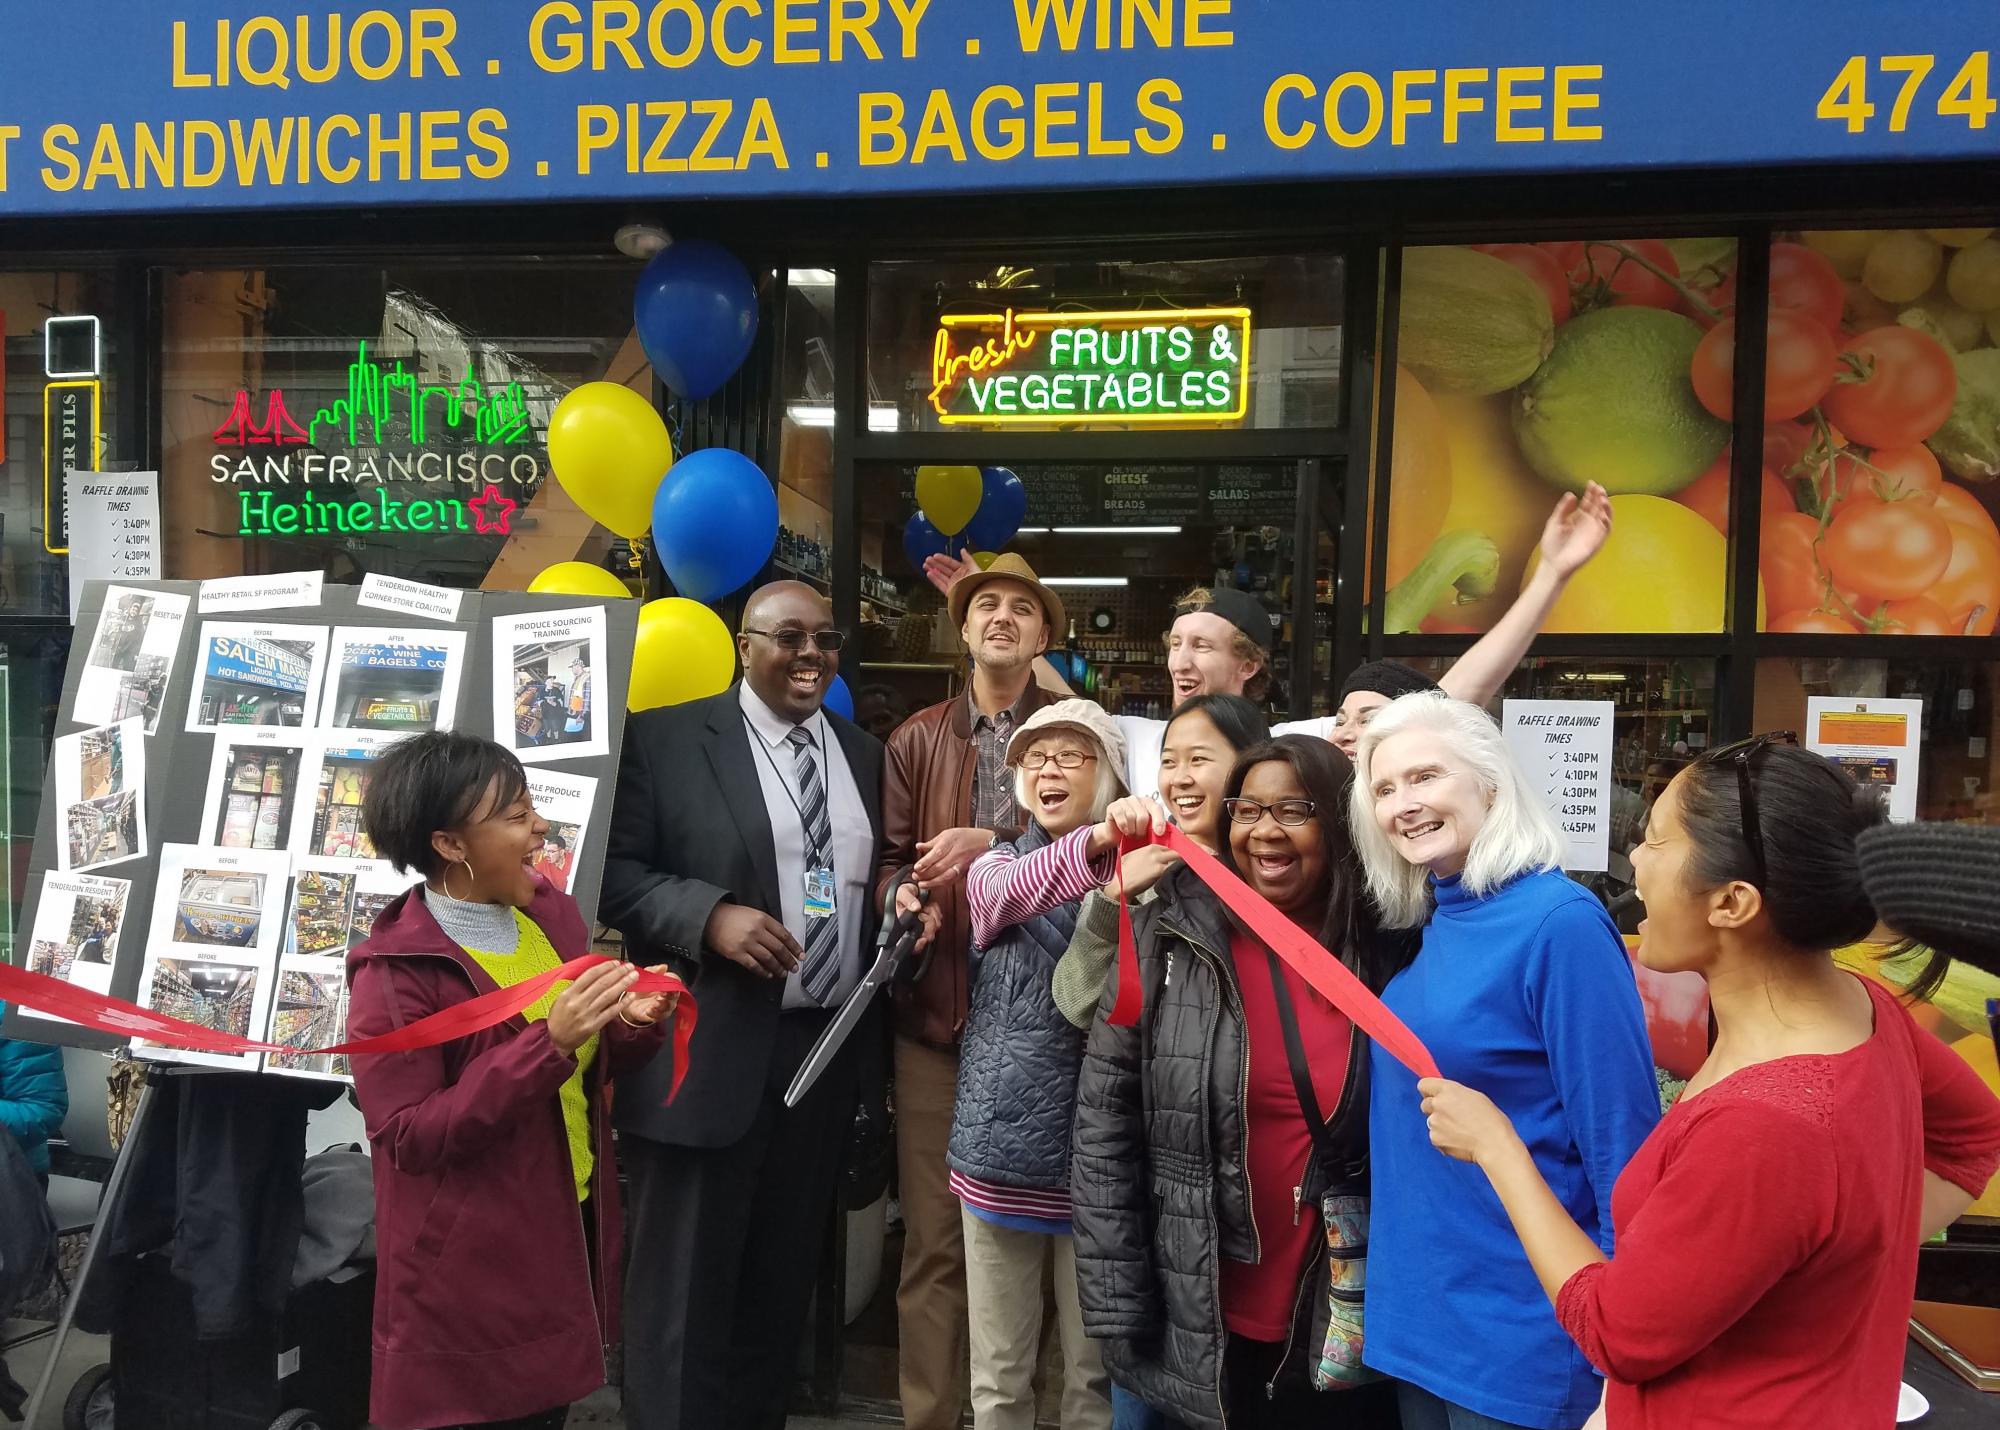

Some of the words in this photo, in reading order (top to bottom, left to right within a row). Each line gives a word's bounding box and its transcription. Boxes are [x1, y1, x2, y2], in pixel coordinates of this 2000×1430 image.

[172, 9, 460, 89] LIQUOR
[528, 0, 931, 73] GROCERY
[1013, 0, 1235, 53] WINE
[1815, 51, 1998, 133] 474
[0, 126, 20, 192] T
[41, 108, 510, 192] SANDWICHES
[577, 98, 790, 176] PIZZA
[858, 78, 1185, 168] BAGELS
[1263, 65, 1604, 151] COFFEE
[1050, 325, 1194, 366] FRUITS
[1208, 324, 1239, 363] &
[967, 370, 1231, 412] VEGETABLES
[62, 394, 77, 440] PILS
[211, 453, 290, 483] SAN
[303, 452, 539, 484] FRANCISCO
[1104, 473, 1149, 484] CHEESE
[81, 485, 114, 496] RAFFLE
[115, 485, 149, 496] DRAWING
[1208, 489, 1250, 500] SALADS
[106, 501, 131, 511] TIMES
[1104, 499, 1146, 509] BREADS
[239, 487, 470, 535] Heineken
[123, 519, 151, 529] 3:40PM
[125, 535, 150, 544] 4:10PM
[124, 551, 151, 560] 4:30PM
[125, 566, 151, 576] 4:35PM
[201, 591, 230, 600] HEALTHY
[231, 591, 252, 599] RETAIL
[254, 589, 262, 597] SF
[263, 587, 299, 597] PROGRAM
[376, 579, 418, 594] TENDERLOIN
[418, 587, 449, 600] HEALTHY
[364, 591, 392, 602] CORNER
[392, 597, 414, 608] STORE
[415, 601, 452, 615] COALITION
[153, 610, 170, 619] RESET
[170, 612, 182, 620] DAY
[514, 621, 551, 631] PRODUCE
[552, 616, 593, 627] SOURCING
[533, 628, 571, 638] TRAINING
[213, 637, 276, 672] SALEM
[279, 660, 310, 680] MARK
[393, 650, 422, 658] WINE
[368, 656, 417, 667] BAGELS
[217, 666, 237, 678] HOT
[1517, 715, 1554, 726] RAFFLE
[1555, 715, 1601, 727] DRAWING
[1544, 733, 1573, 744] TIMES
[1563, 752, 1599, 763] 3:40PM
[1564, 770, 1598, 781] 4:10PM
[544, 785, 582, 798] PRODUCE
[1562, 787, 1597, 798] 4:30PM
[530, 793, 554, 804] ARKET
[1561, 804, 1597, 815] 4:35PM
[218, 857, 238, 865] BEFORE
[48, 881, 84, 893] TENDERLOIN
[84, 885, 113, 897] RESIDENT
